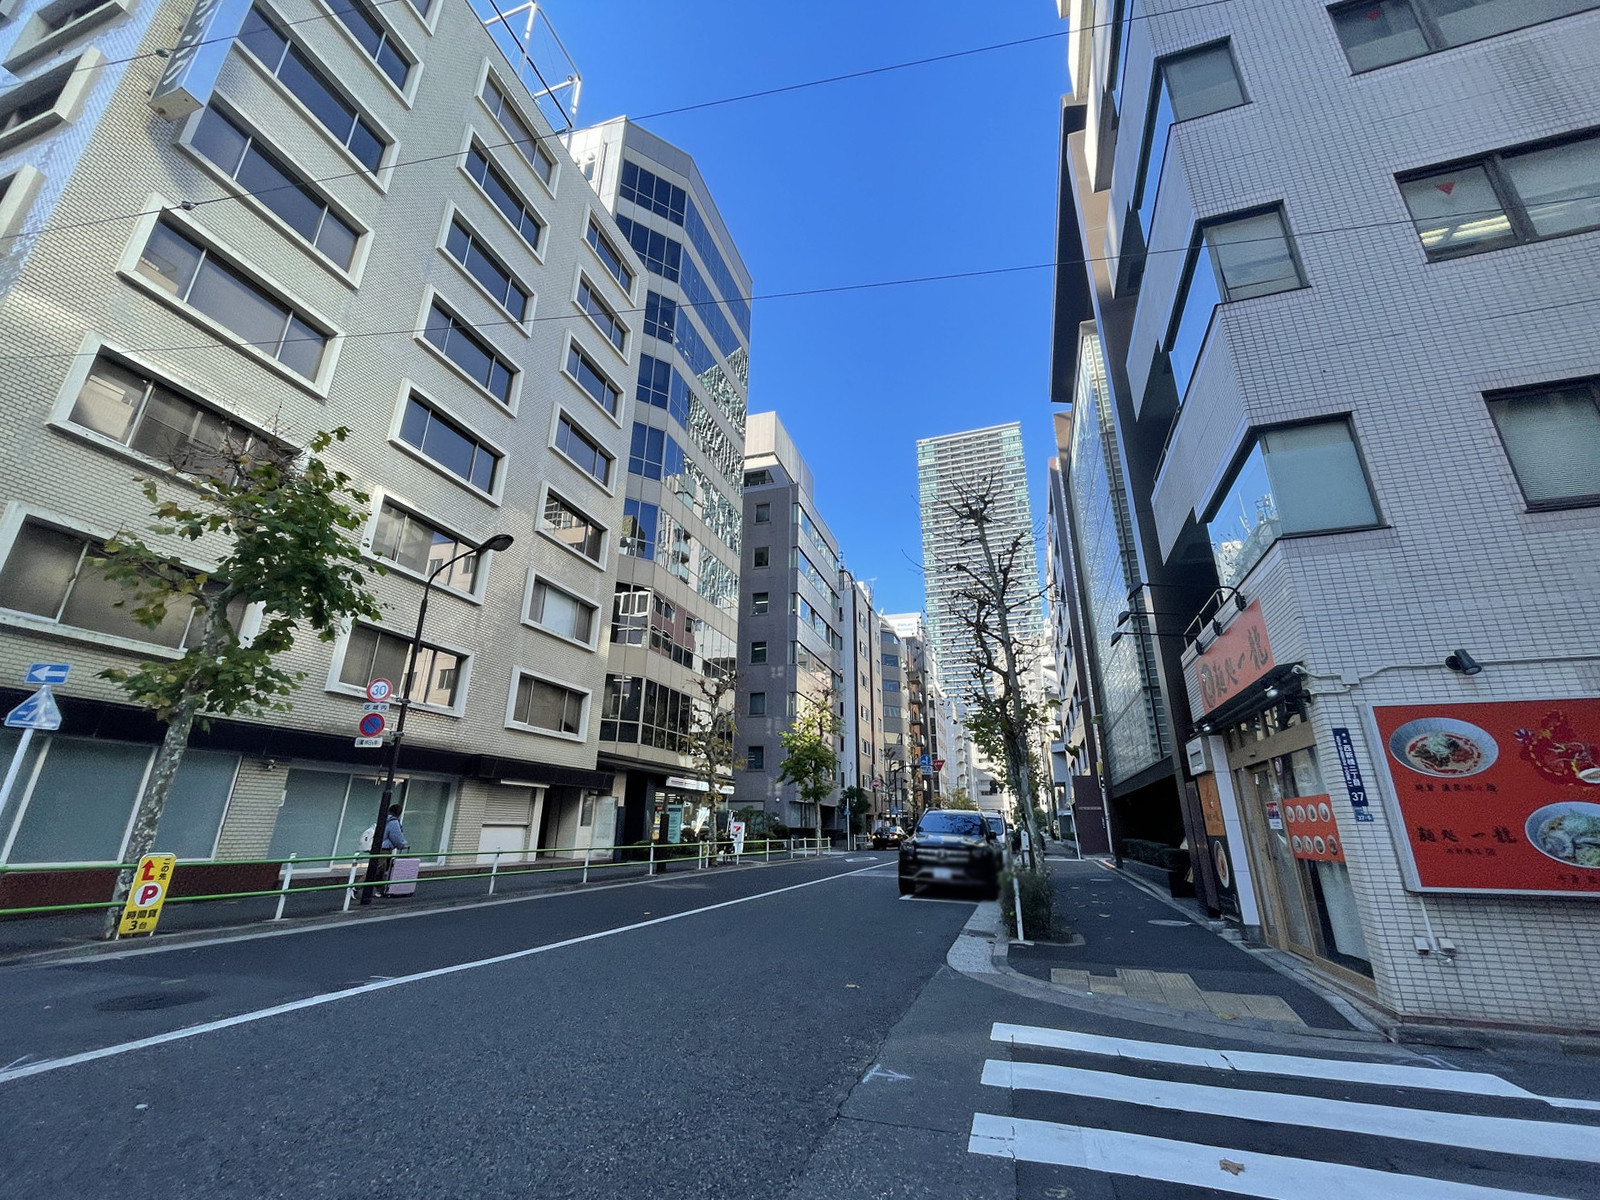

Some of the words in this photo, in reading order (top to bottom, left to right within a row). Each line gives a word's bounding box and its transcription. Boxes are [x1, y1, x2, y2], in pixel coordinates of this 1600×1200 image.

[372, 685, 387, 696] 30
[1351, 792, 1364, 801] 37
[158, 858, 171, 880] この先
[139, 885, 159, 905] P
